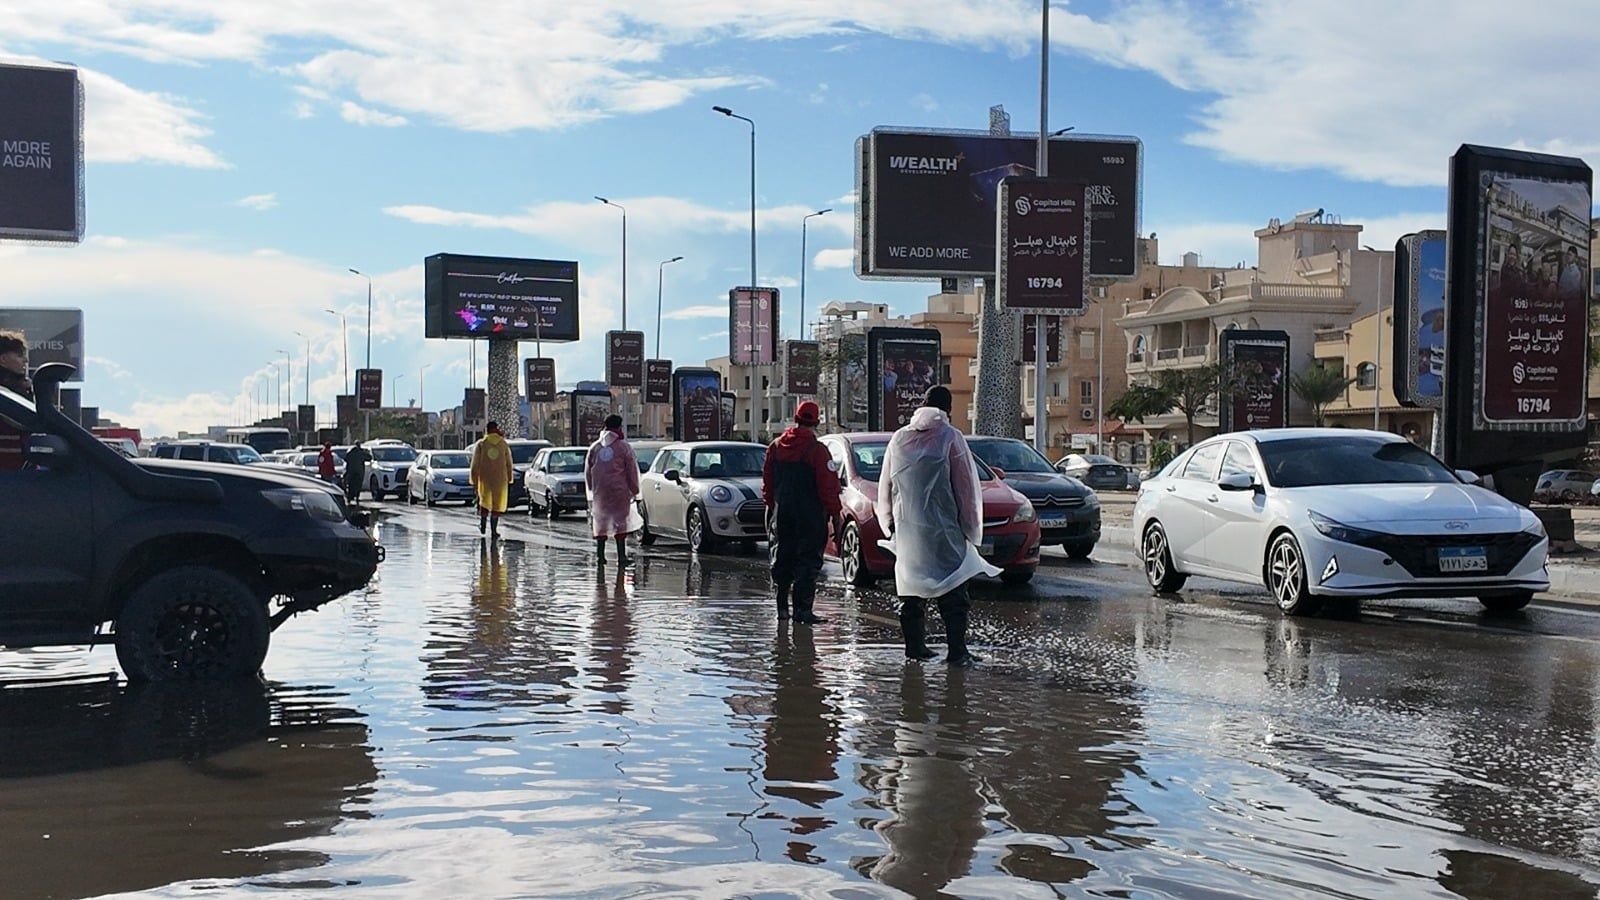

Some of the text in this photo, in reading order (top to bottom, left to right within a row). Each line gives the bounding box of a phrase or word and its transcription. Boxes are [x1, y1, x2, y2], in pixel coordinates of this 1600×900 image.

[4, 140, 51, 155] MORE
[3, 154, 52, 169] AGAIN
[889, 156, 957, 170] WEALTH
[1033, 198, 1059, 207] Capital
[1012, 235, 1078, 248] كابيتال هيلز
[888, 246, 971, 259] WE ADD MORE.
[1027, 277, 1063, 288] 16794
[1531, 329, 1564, 343] كابيتال
[1517, 398, 1551, 413] 16794
